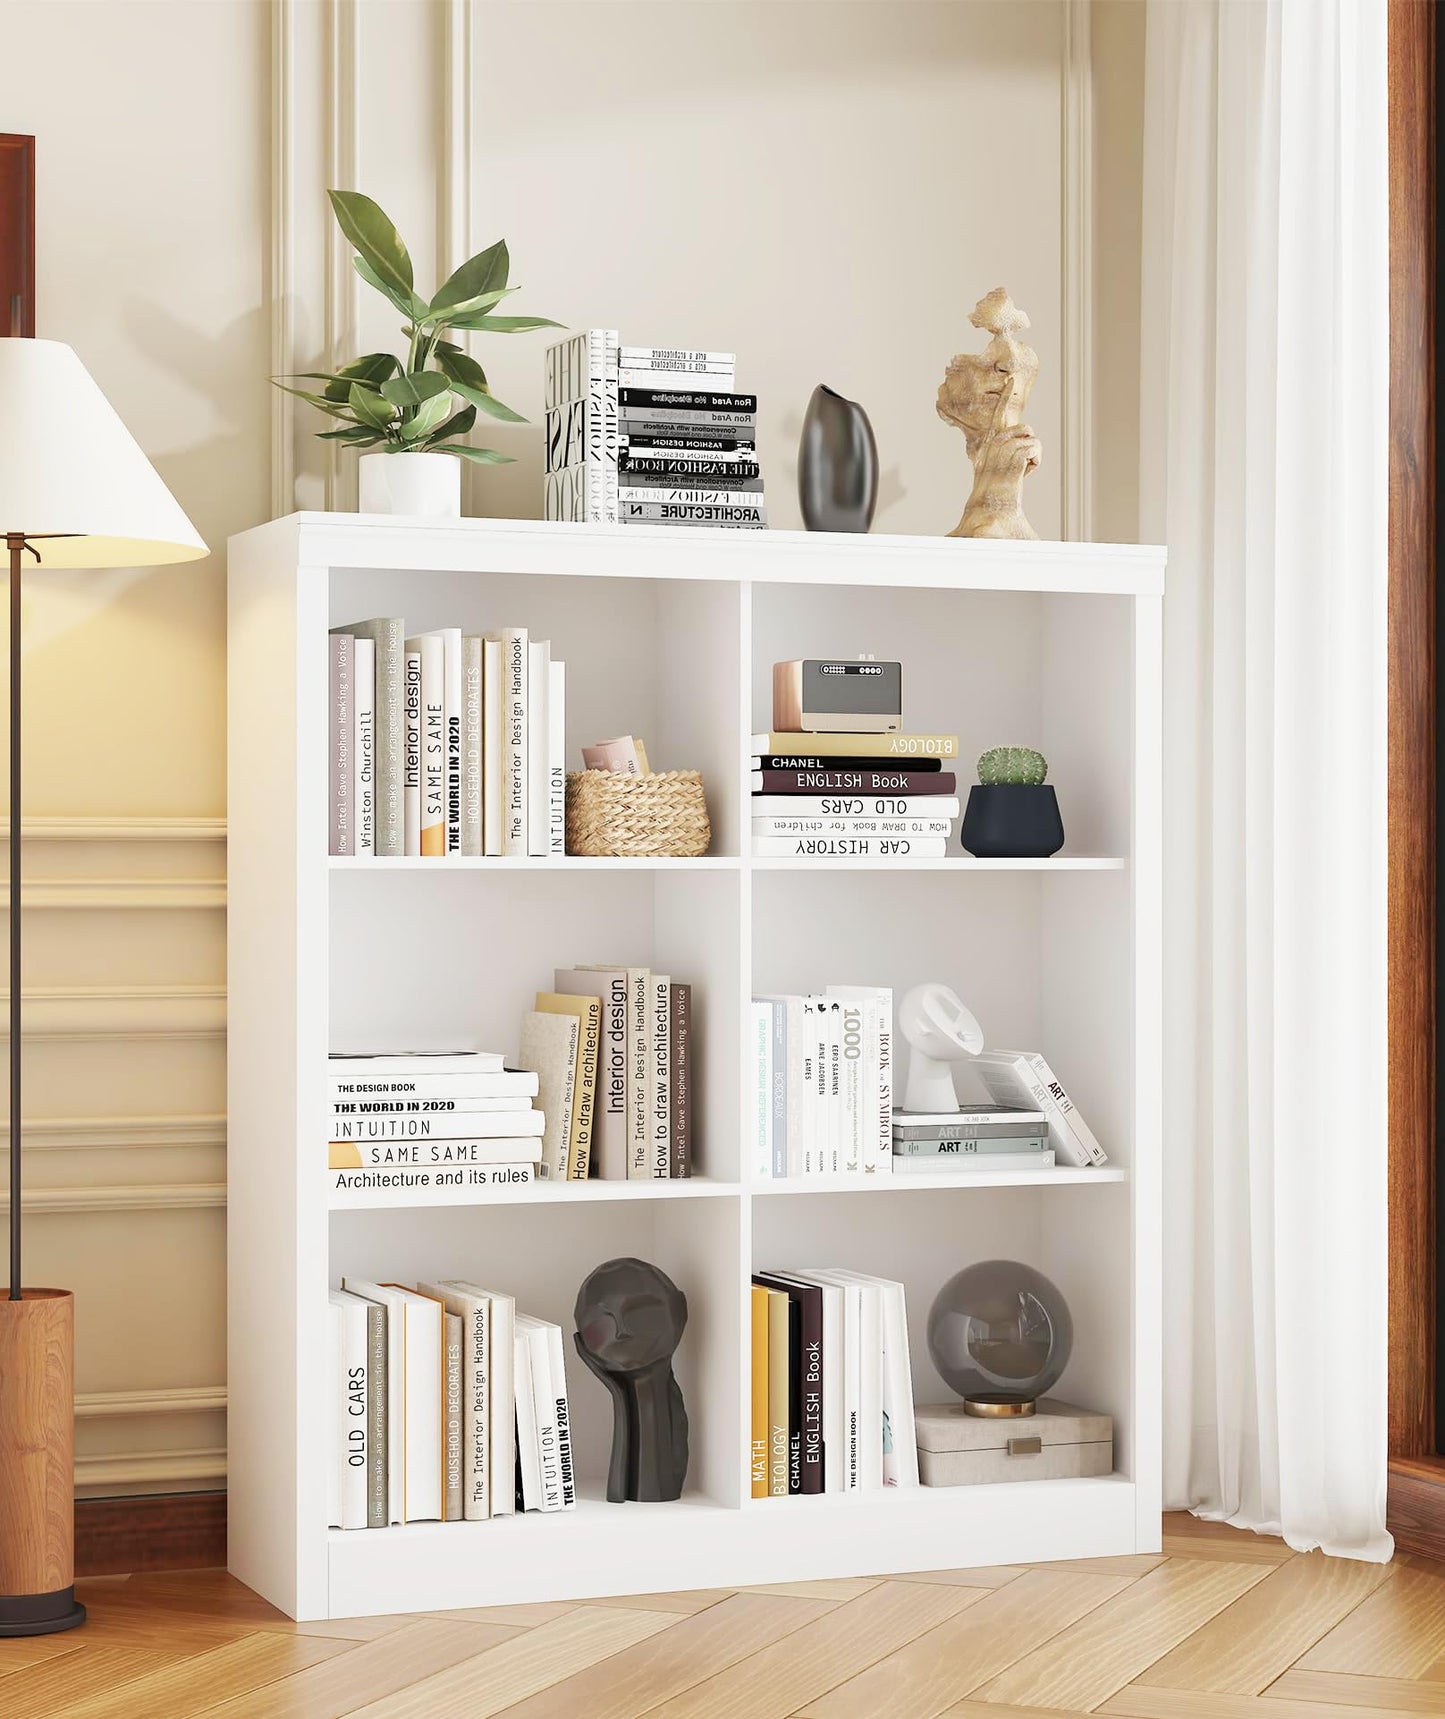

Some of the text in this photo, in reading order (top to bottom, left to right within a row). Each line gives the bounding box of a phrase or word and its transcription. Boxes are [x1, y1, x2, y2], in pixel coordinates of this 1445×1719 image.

[338, 639, 347, 667] Voice
[338, 684, 348, 723] Hawking
[404, 660, 421, 788] Interior design
[338, 729, 348, 768] Stephen
[388, 623, 398, 848] How to make an arrangement in the house
[468, 667, 480, 823] HOUSEHOLD DECORATES
[511, 637, 523, 839] The Interior Design Handbook
[890, 739, 953, 754] BIOLOGY
[361, 711, 372, 847] Winston Churchill
[427, 703, 442, 814] SAME SAME
[772, 758, 824, 768] CHANEL
[338, 774, 348, 796] Gave
[449, 717, 460, 851] THE WORLD IN 2020
[797, 774, 909, 788] ENGLISH Book
[338, 802, 347, 829] Intel
[551, 767, 563, 853] INTUITION
[774, 821, 948, 831] HOW TO DRAW Book for children
[821, 799, 907, 814] OLD CARS
[338, 835, 347, 852] How
[796, 840, 910, 854] CAR HISTORY
[677, 990, 685, 1015] Voice
[607, 979, 627, 1113] Interior design
[677, 1029, 686, 1065] Hawking
[844, 1008, 861, 1060] 1000
[338, 1083, 415, 1093] THE DESIGN BOOK
[573, 1004, 599, 1179] How to draw architecture
[634, 976, 647, 1168] The Interior Design Handbook
[654, 984, 667, 1179] How to draw architecture
[677, 1069, 686, 1105] Stephen
[879, 1033, 890, 1151] BOOK SYMBOLS
[1048, 1081, 1065, 1101] ART
[334, 1101, 455, 1113] THE WORLD IN 2020
[558, 1022, 577, 1172] The Interior Design Handbook
[335, 1120, 430, 1137] INTUITION
[677, 1135, 685, 1159] Intel
[938, 1128, 960, 1138] ART
[938, 1141, 961, 1153] ART
[372, 1145, 478, 1163] SAME SAME
[336, 1169, 529, 1189] Architecture and its rules
[348, 1367, 365, 1467] OLD CARS
[374, 1311, 384, 1518] How to make an arrangement in the house
[448, 1345, 460, 1489] HOUSEHOLD DECORATES
[473, 1308, 485, 1502] The Interior Design Handbook
[806, 1341, 820, 1463] ENGLISH Book
[541, 1426, 559, 1506] INTUITION
[556, 1398, 574, 1505] THE WORLD IN 2020
[752, 1440, 766, 1481] MATH
[773, 1425, 787, 1494] BIOLOGY
[791, 1431, 800, 1489] CHANEL
